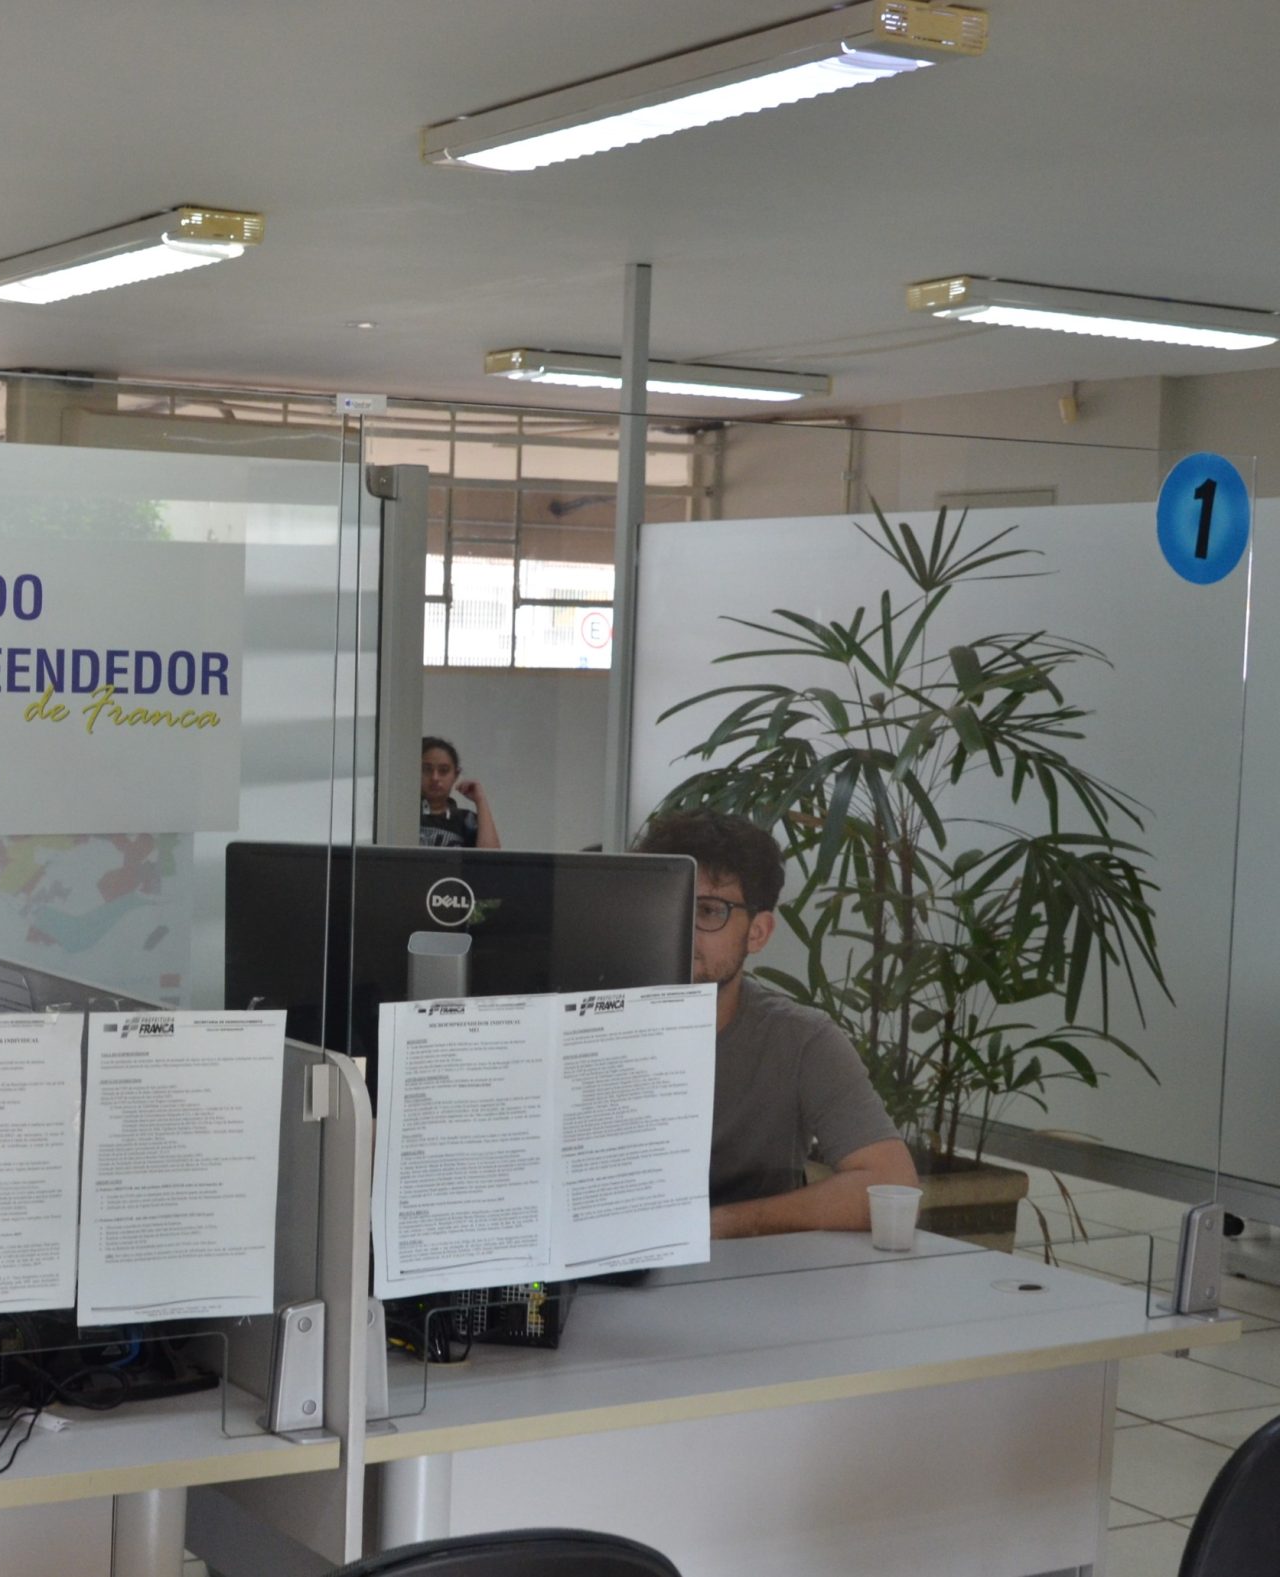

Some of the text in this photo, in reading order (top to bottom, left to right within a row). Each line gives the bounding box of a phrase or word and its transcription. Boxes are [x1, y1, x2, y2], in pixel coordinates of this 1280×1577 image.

[1193, 477, 1217, 560] 1
[23, 684, 221, 735] de Franca
[431, 894, 470, 908] DELL
[594, 1000, 625, 1012] FRANCA
[138, 1023, 175, 1034] FRANCA
